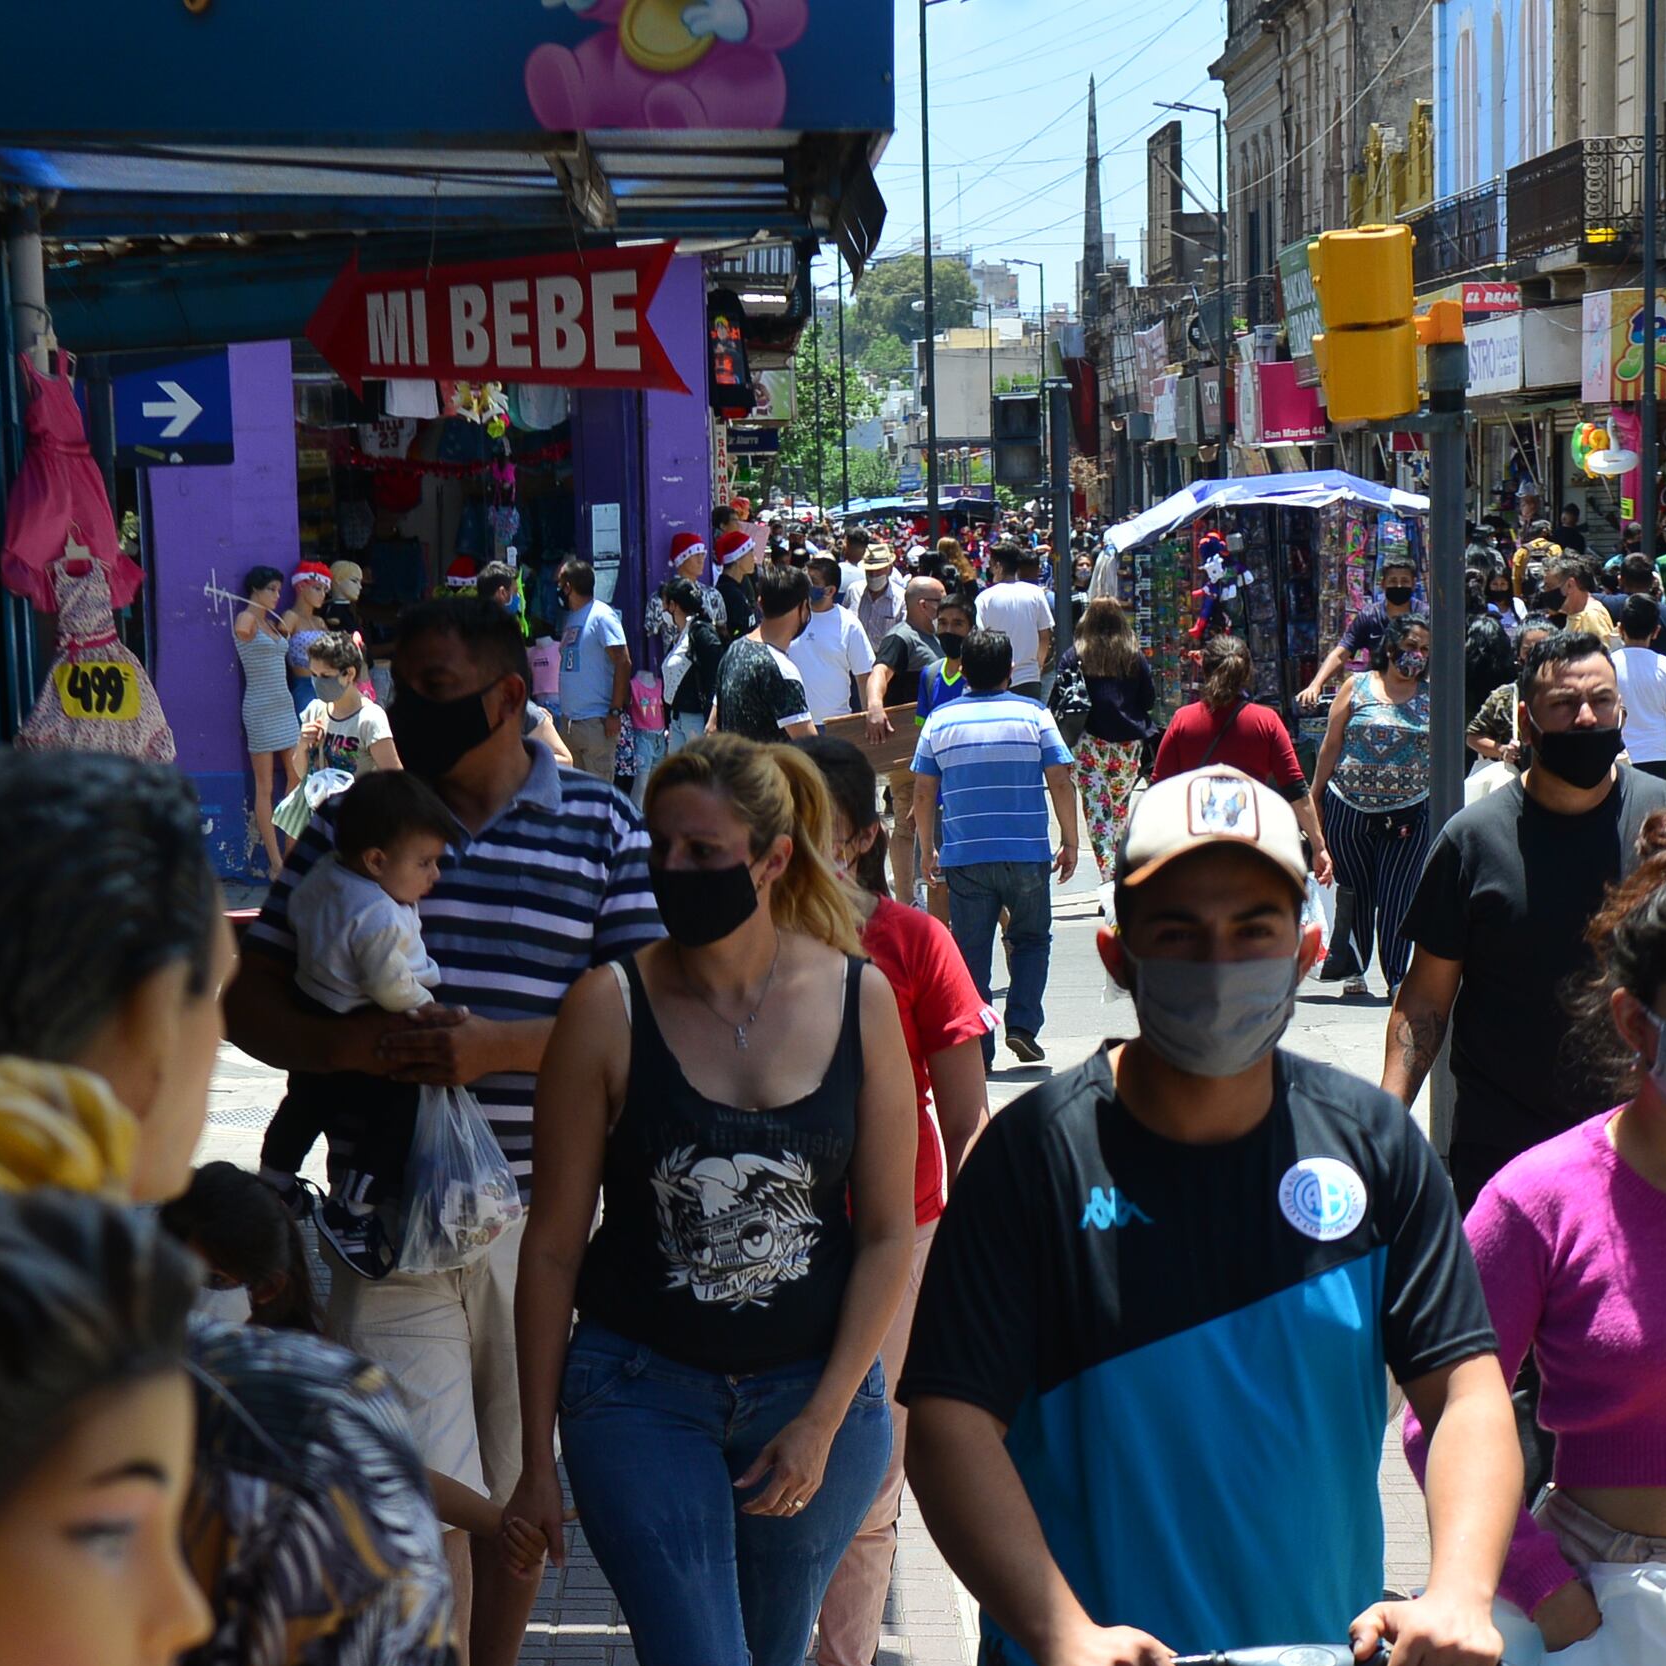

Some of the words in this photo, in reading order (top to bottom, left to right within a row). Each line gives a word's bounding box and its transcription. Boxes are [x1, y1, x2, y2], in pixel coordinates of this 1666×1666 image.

[365, 288, 430, 366] MI
[448, 269, 642, 372] BEBE
[379, 431, 400, 449] 23
[1264, 430, 1281, 439] San
[1282, 428, 1310, 437] Martin
[717, 438, 726, 468] SAN
[67, 665, 125, 713] 499
